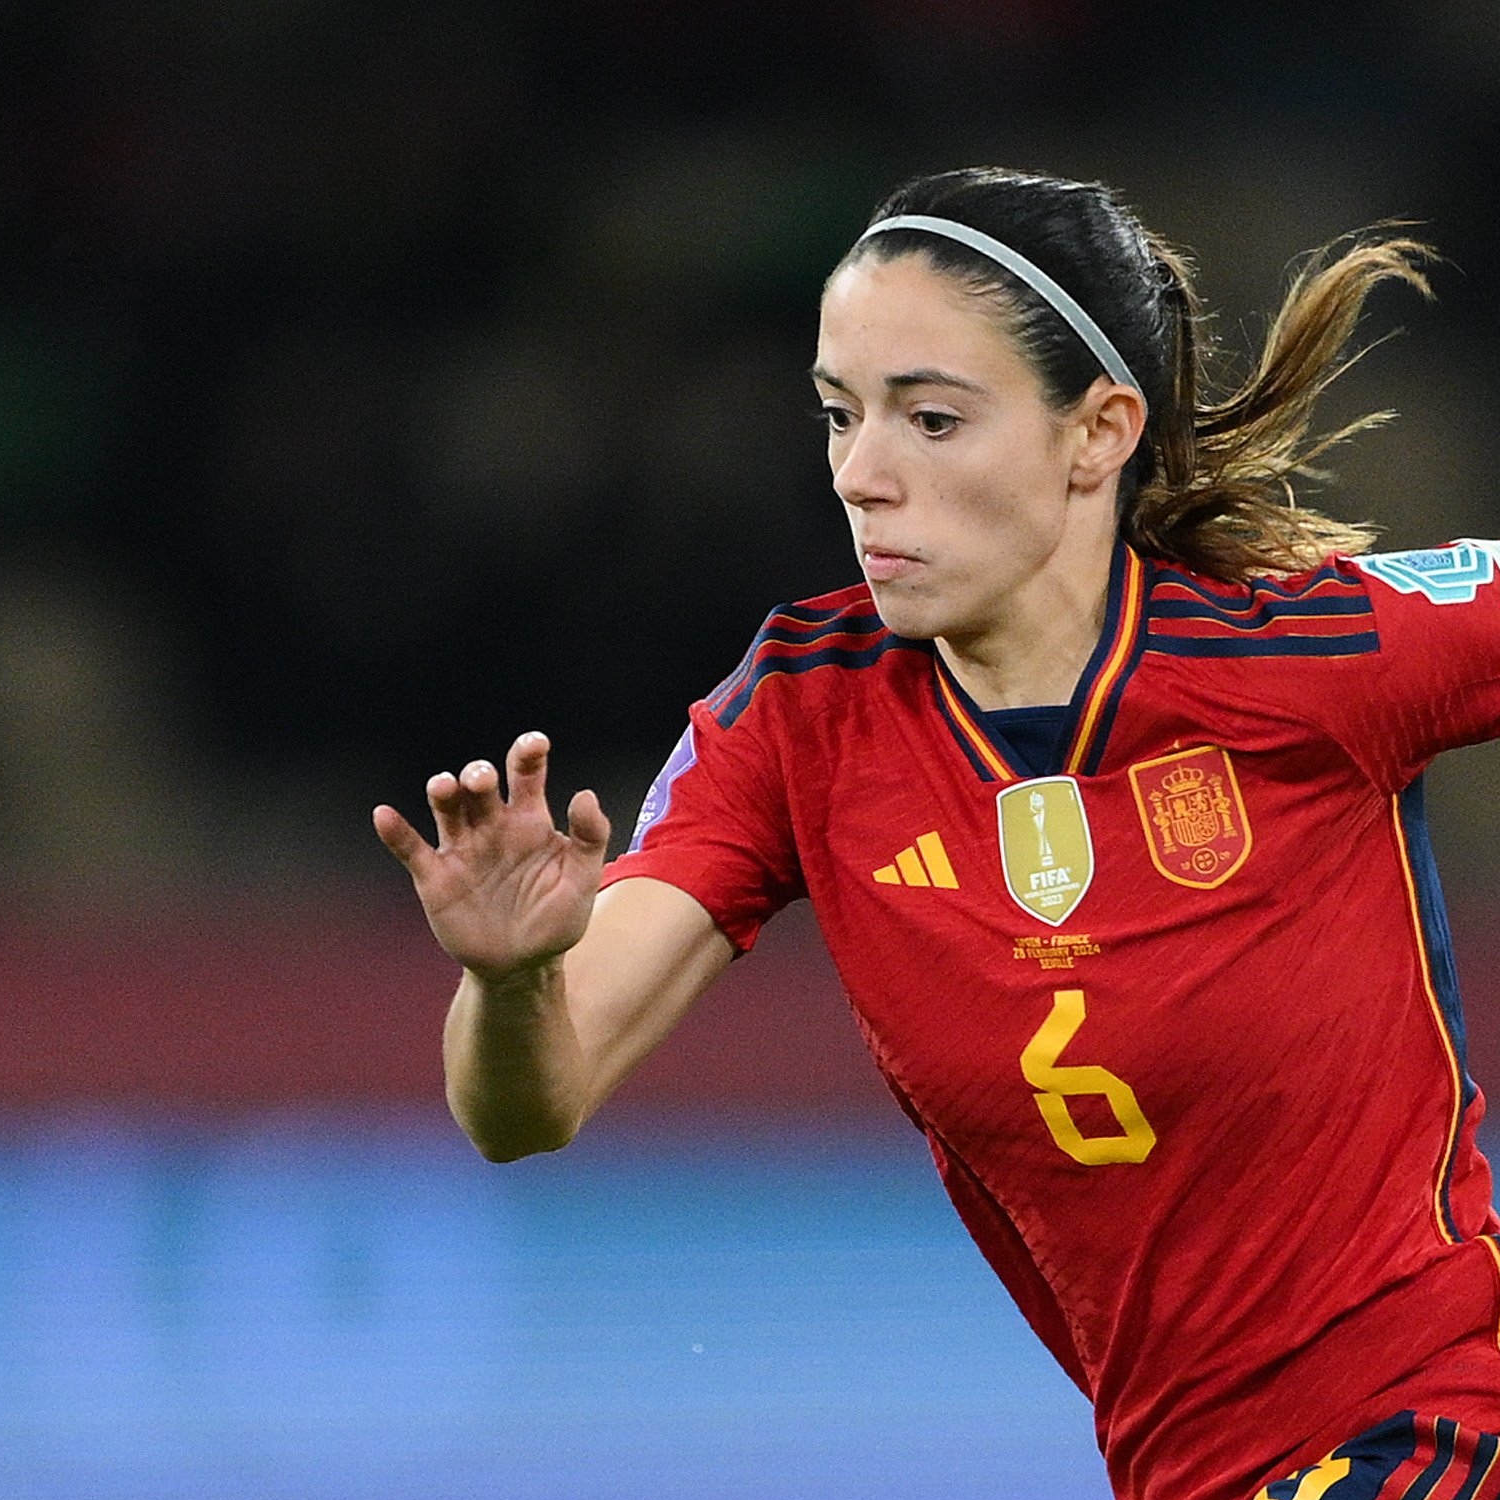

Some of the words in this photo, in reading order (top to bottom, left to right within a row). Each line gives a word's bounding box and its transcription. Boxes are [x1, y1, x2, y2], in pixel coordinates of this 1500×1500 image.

[1029, 867, 1071, 890] FIFA
[1071, 944, 1101, 956] 2024
[1019, 990, 1157, 1166] 6
